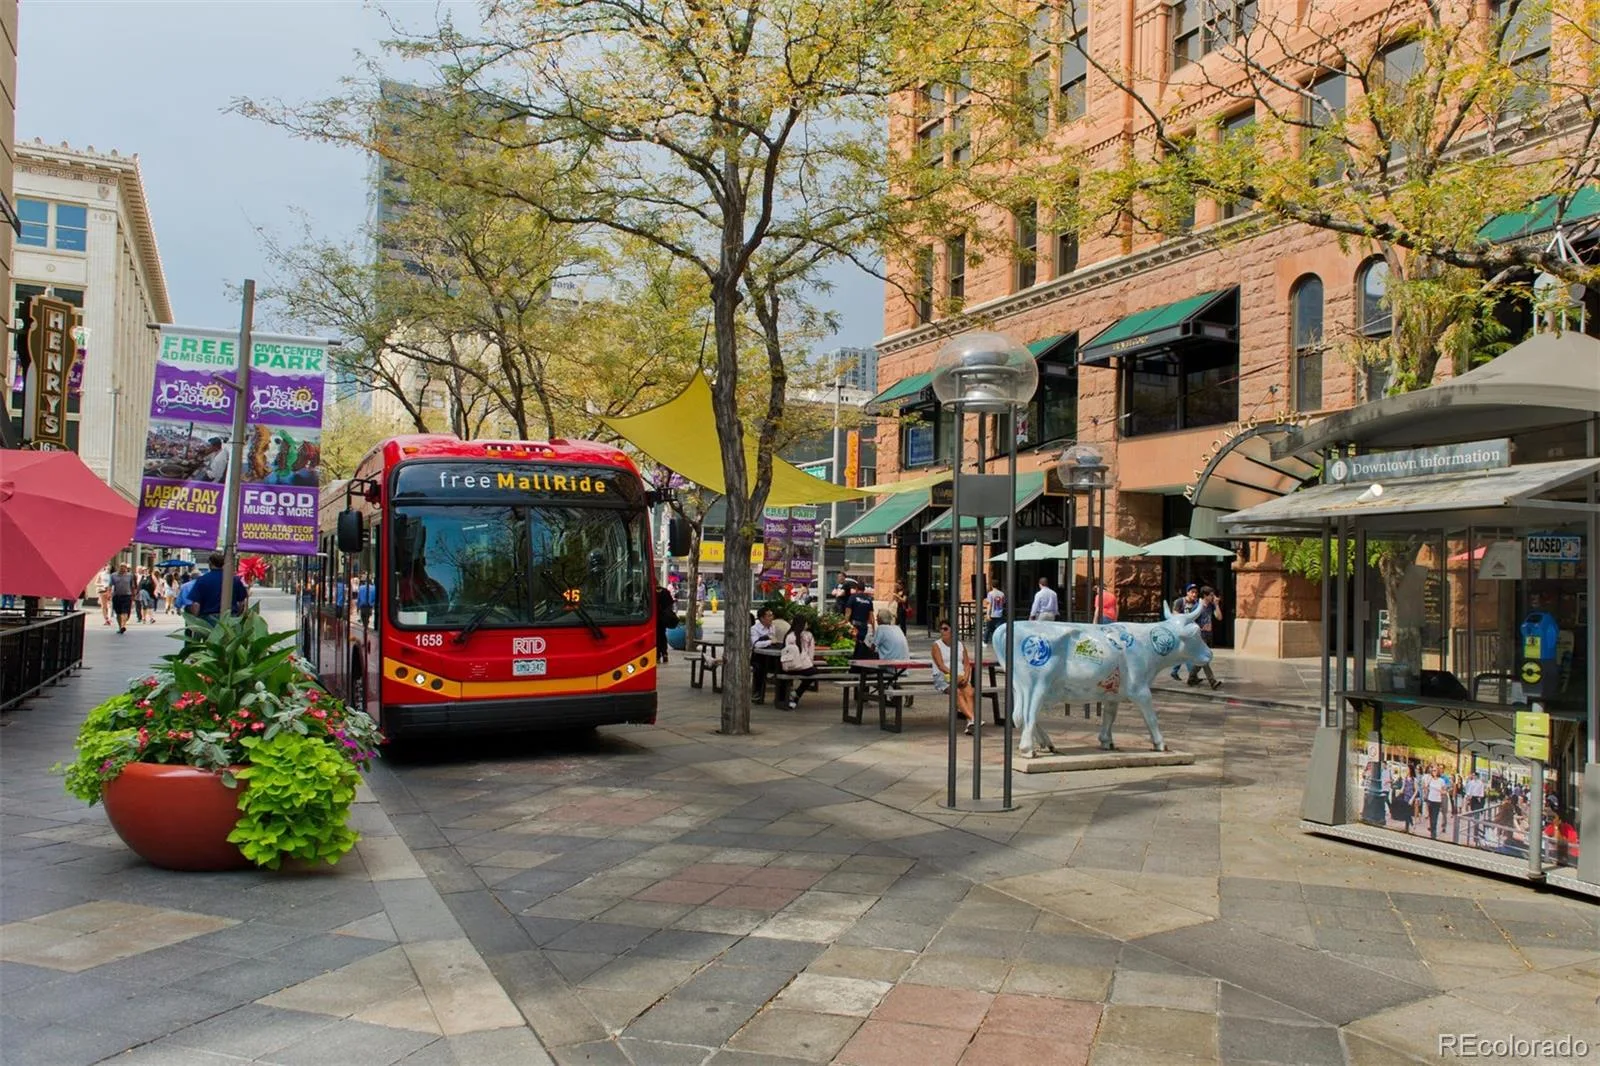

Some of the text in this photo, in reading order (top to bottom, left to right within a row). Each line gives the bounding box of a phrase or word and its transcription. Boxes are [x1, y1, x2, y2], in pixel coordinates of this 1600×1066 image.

[163, 336, 235, 356] FREE
[254, 343, 323, 358] CIVIC CENTER
[162, 350, 235, 365] ADMISSION
[254, 353, 322, 371] PARK
[43, 311, 63, 434] HENRY'S
[1183, 415, 1258, 501] MASONIC
[1352, 448, 1500, 475] Downtown information
[440, 472, 605, 492] free MallRide
[146, 484, 219, 505] LABOR DAY
[244, 490, 314, 508] FOOD
[144, 499, 217, 514] WEEKEND
[243, 505, 314, 518] MUSIC & MORE
[242, 531, 314, 541] COLORADO.COM
[243, 523, 314, 533] WWW.ATASTEOF
[1528, 538, 1561, 553] CLOSED
[415, 634, 443, 647] 1658
[513, 637, 546, 655] RTD
